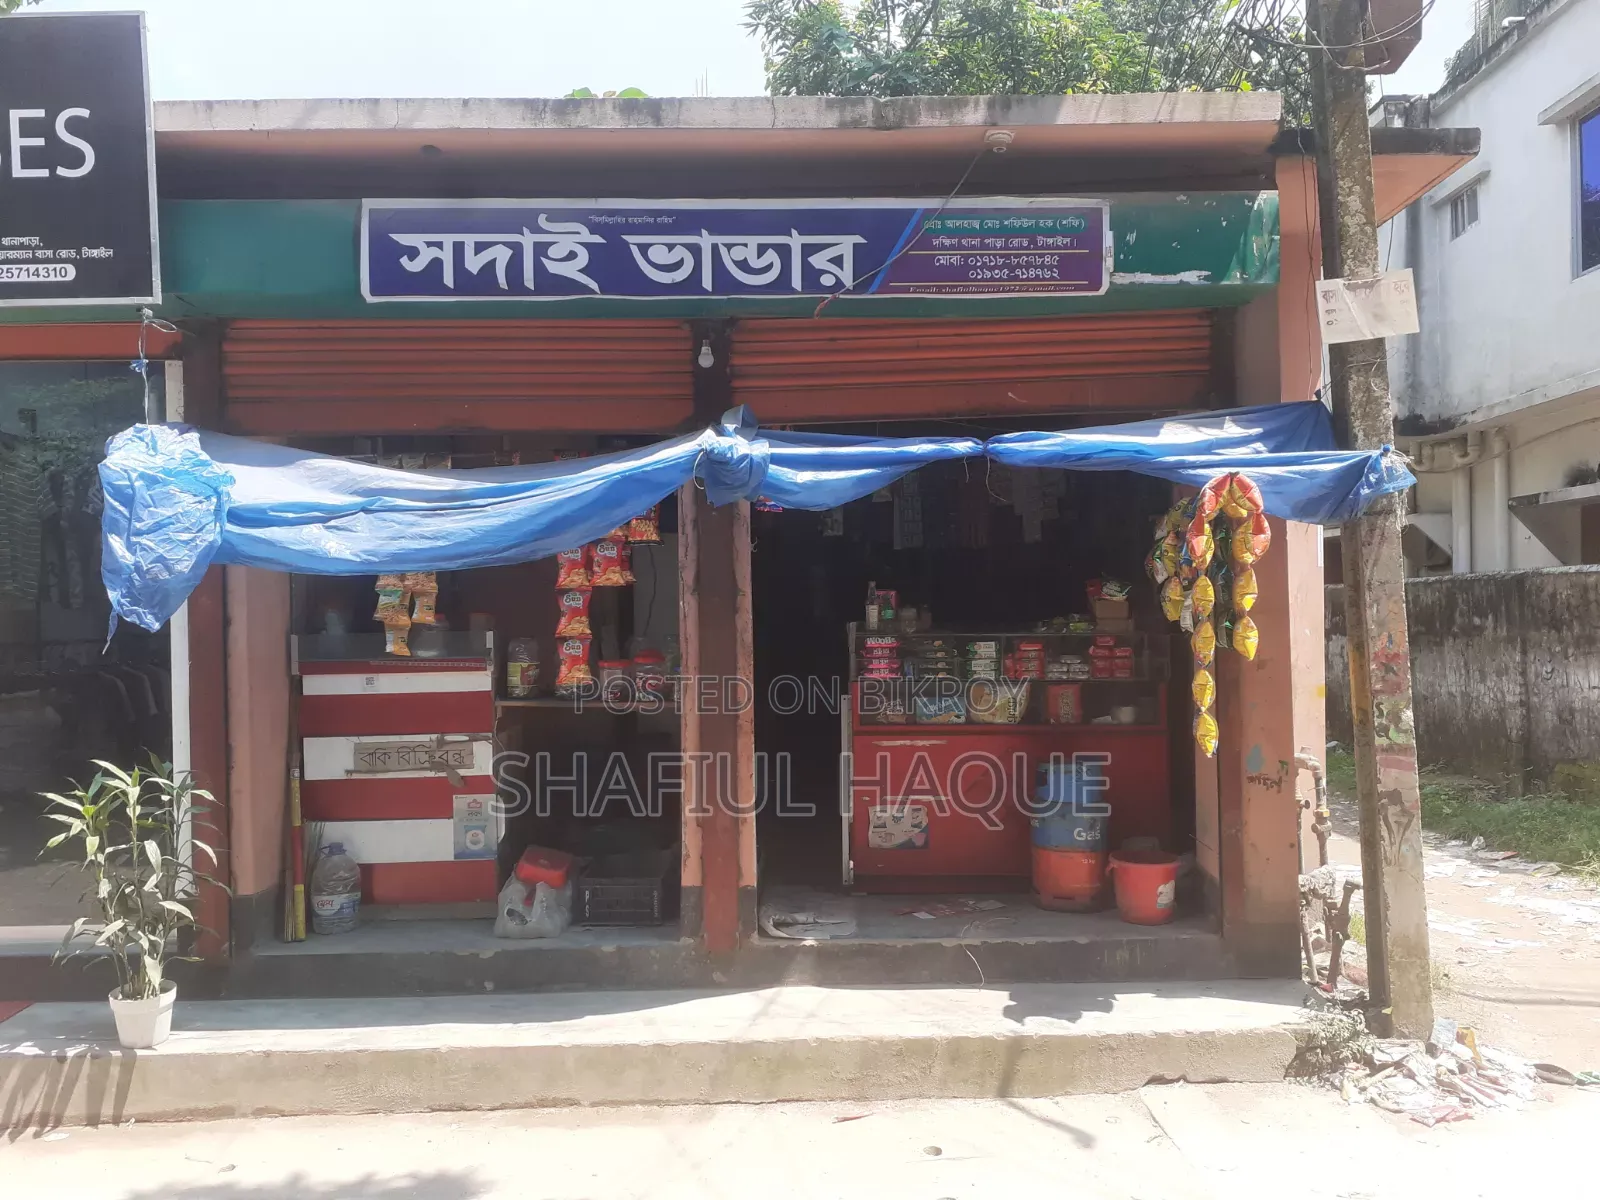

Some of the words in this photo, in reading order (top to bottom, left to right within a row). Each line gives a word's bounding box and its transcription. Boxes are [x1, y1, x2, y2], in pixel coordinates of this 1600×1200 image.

[1003, 217, 1035, 229] শফিউল
[1038, 219, 1054, 228] হক
[932, 235, 958, 248] দক্ষিণ
[961, 238, 981, 247] থানা
[984, 238, 1005, 248] পাড়া
[35, 249, 54, 259] বাসা
[81, 246, 114, 259] টাঙ্গাইল
[388, 213, 606, 294] সদাই
[968, 254, 1060, 266] ০১৭১৮-৮৫৭৮৪৫
[968, 267, 1060, 279] ০১৯৩৫-৭১৪৭৬২
[358, 748, 392, 767] বাকি
[437, 748, 466, 765] বন্ধ
[1073, 827, 1101, 841] Gas
